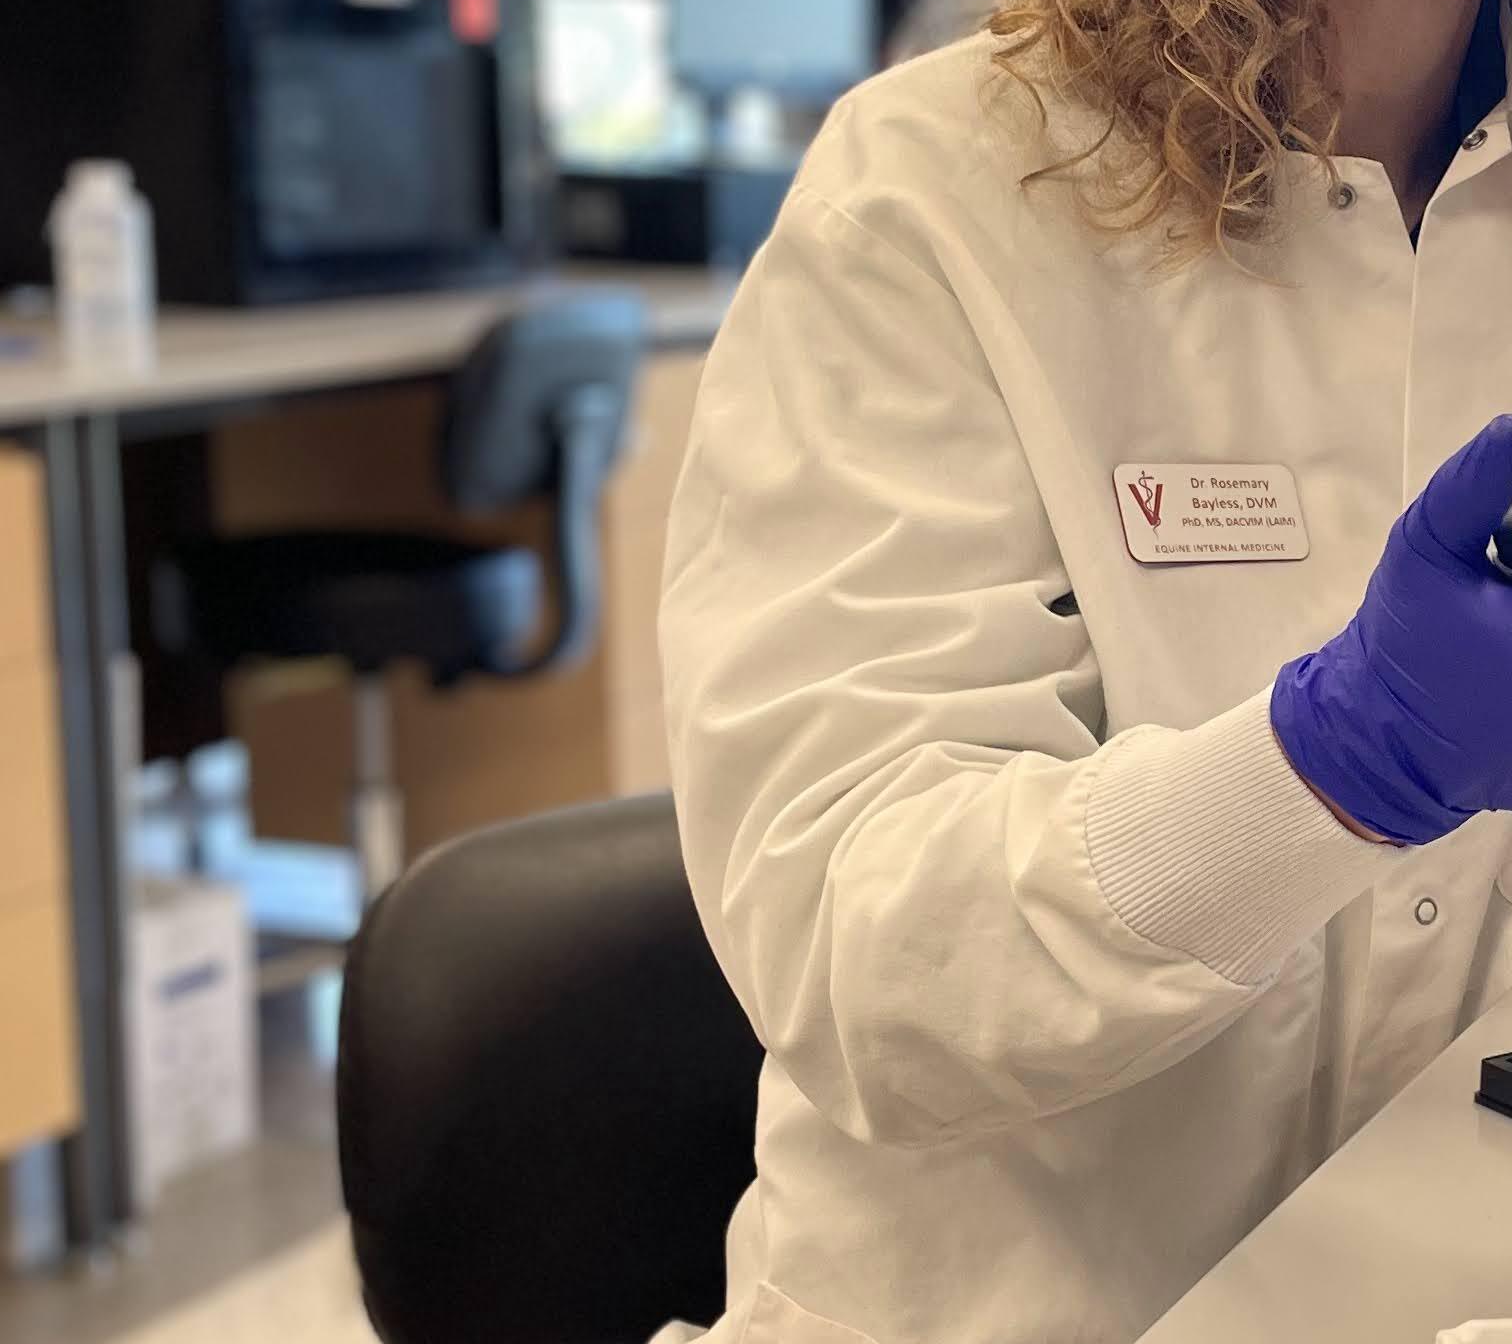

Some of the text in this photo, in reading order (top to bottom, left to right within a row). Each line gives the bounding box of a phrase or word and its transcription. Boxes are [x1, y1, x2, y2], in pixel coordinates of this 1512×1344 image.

[1210, 477, 1270, 492] Rosemary
[1192, 497, 1278, 512] Bayless, DVM
[1155, 543, 1286, 554] EQUINE INTERNAL MEDICINE
